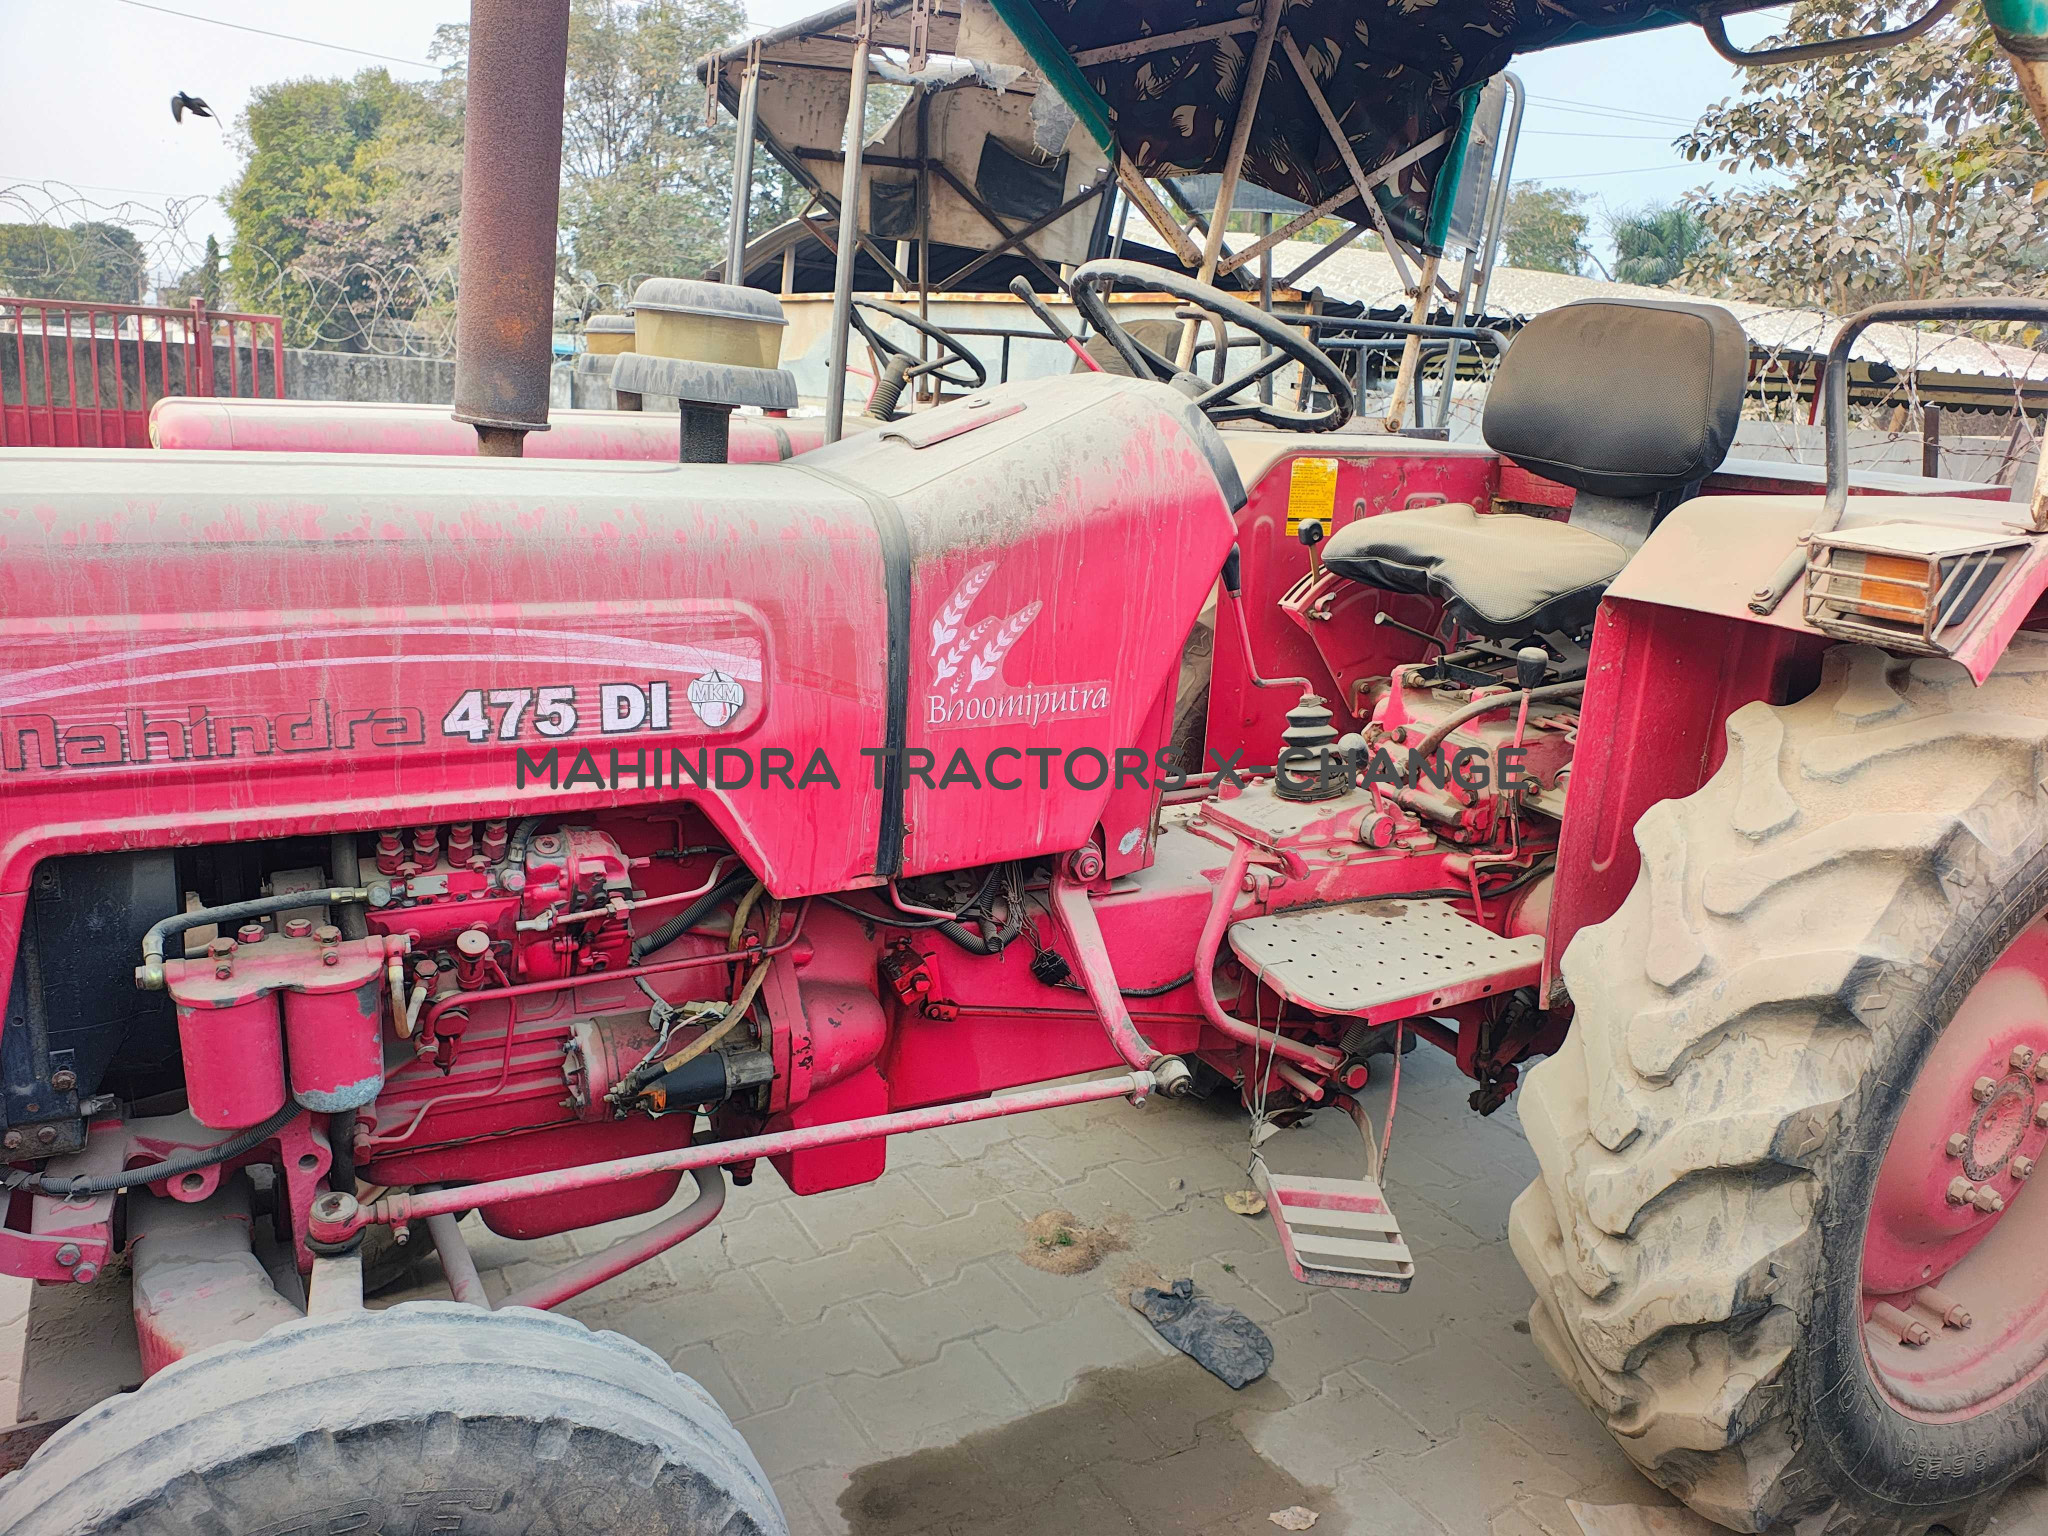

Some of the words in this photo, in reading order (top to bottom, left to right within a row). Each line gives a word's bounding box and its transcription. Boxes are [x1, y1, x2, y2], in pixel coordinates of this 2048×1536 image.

[441, 685, 579, 743] 475
[599, 680, 669, 735] DI
[692, 682, 740, 703] MKM
[926, 684, 1107, 726] Bhoomiputra
